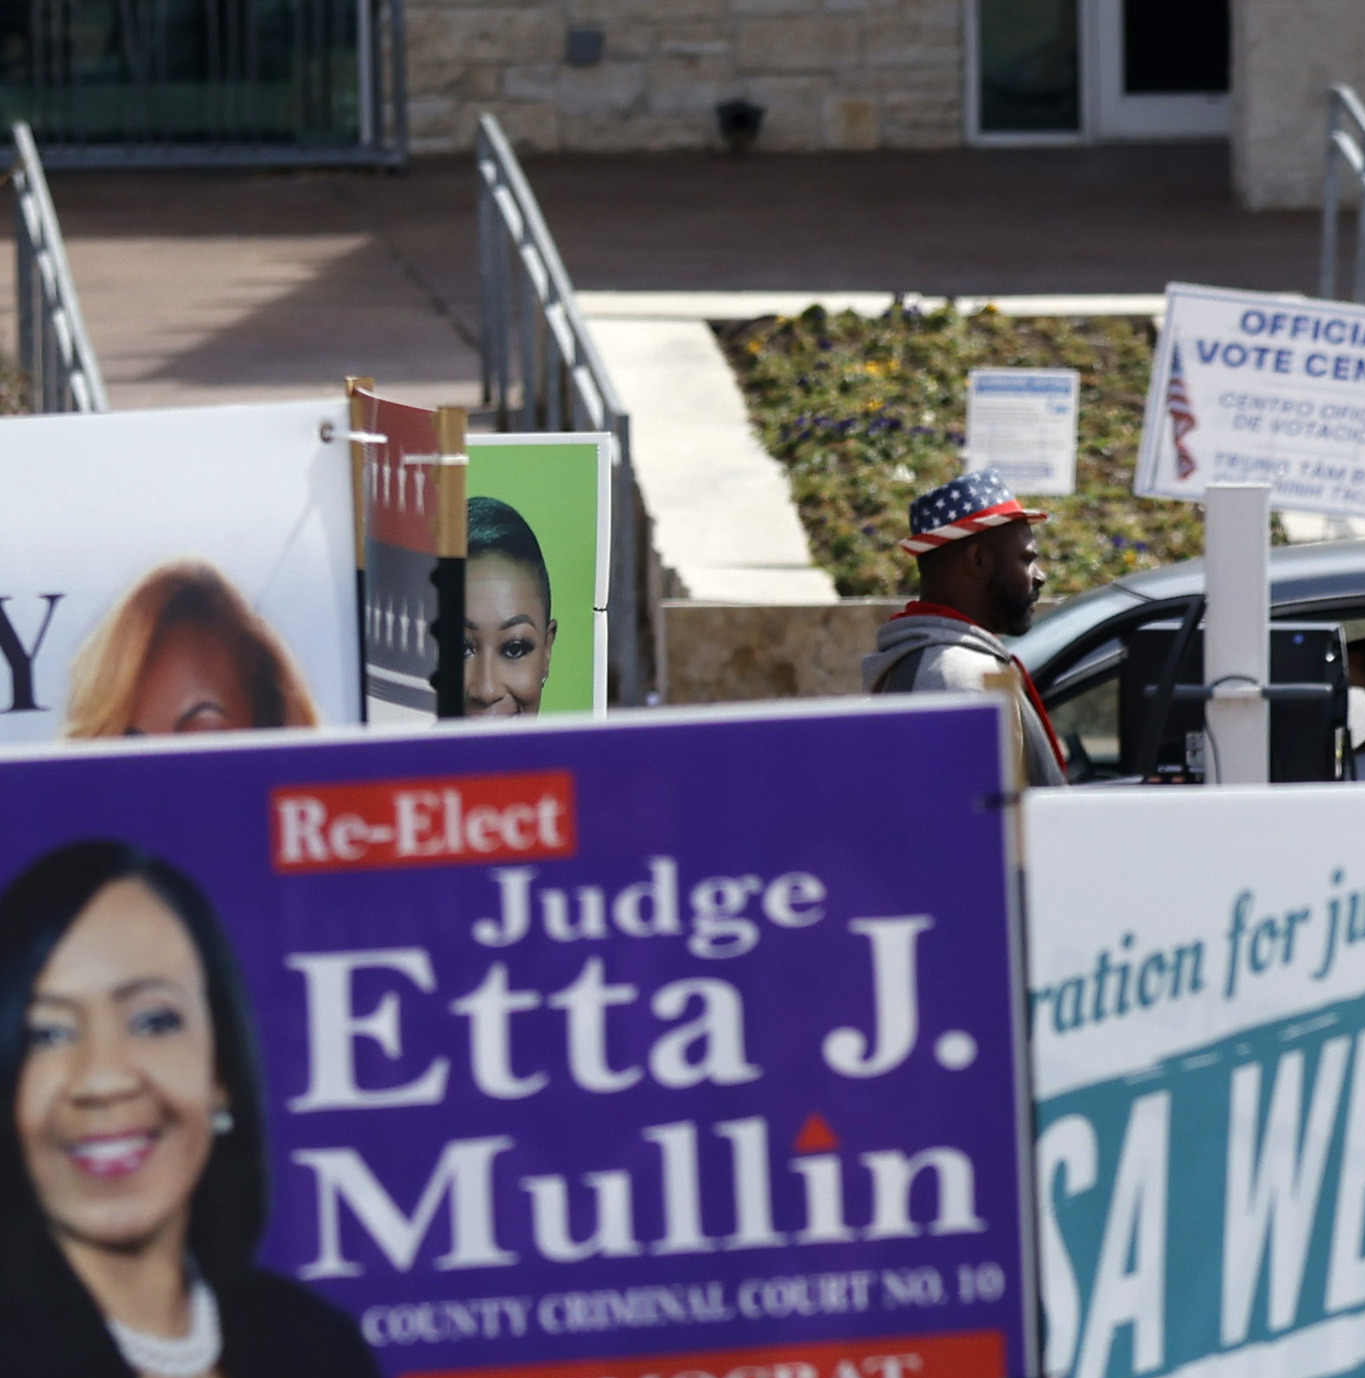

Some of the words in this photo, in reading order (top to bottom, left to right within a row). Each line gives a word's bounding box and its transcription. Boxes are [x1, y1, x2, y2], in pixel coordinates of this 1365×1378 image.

[1196, 339, 1293, 376] VOTE
[1233, 413, 1263, 433] DE
[276, 790, 567, 865] Re-Elect
[472, 856, 828, 960] Judge
[1223, 887, 1308, 1002] for
[286, 946, 764, 1114] Etta
[820, 914, 979, 1080] J.
[290, 1113, 988, 1281] Mullin
[362, 1297, 527, 1347] COUNTY
[539, 1280, 734, 1337] CRIMINAL
[738, 1269, 873, 1321] COURT
[882, 1265, 950, 1310] NO.
[959, 1261, 1006, 1304] 10
